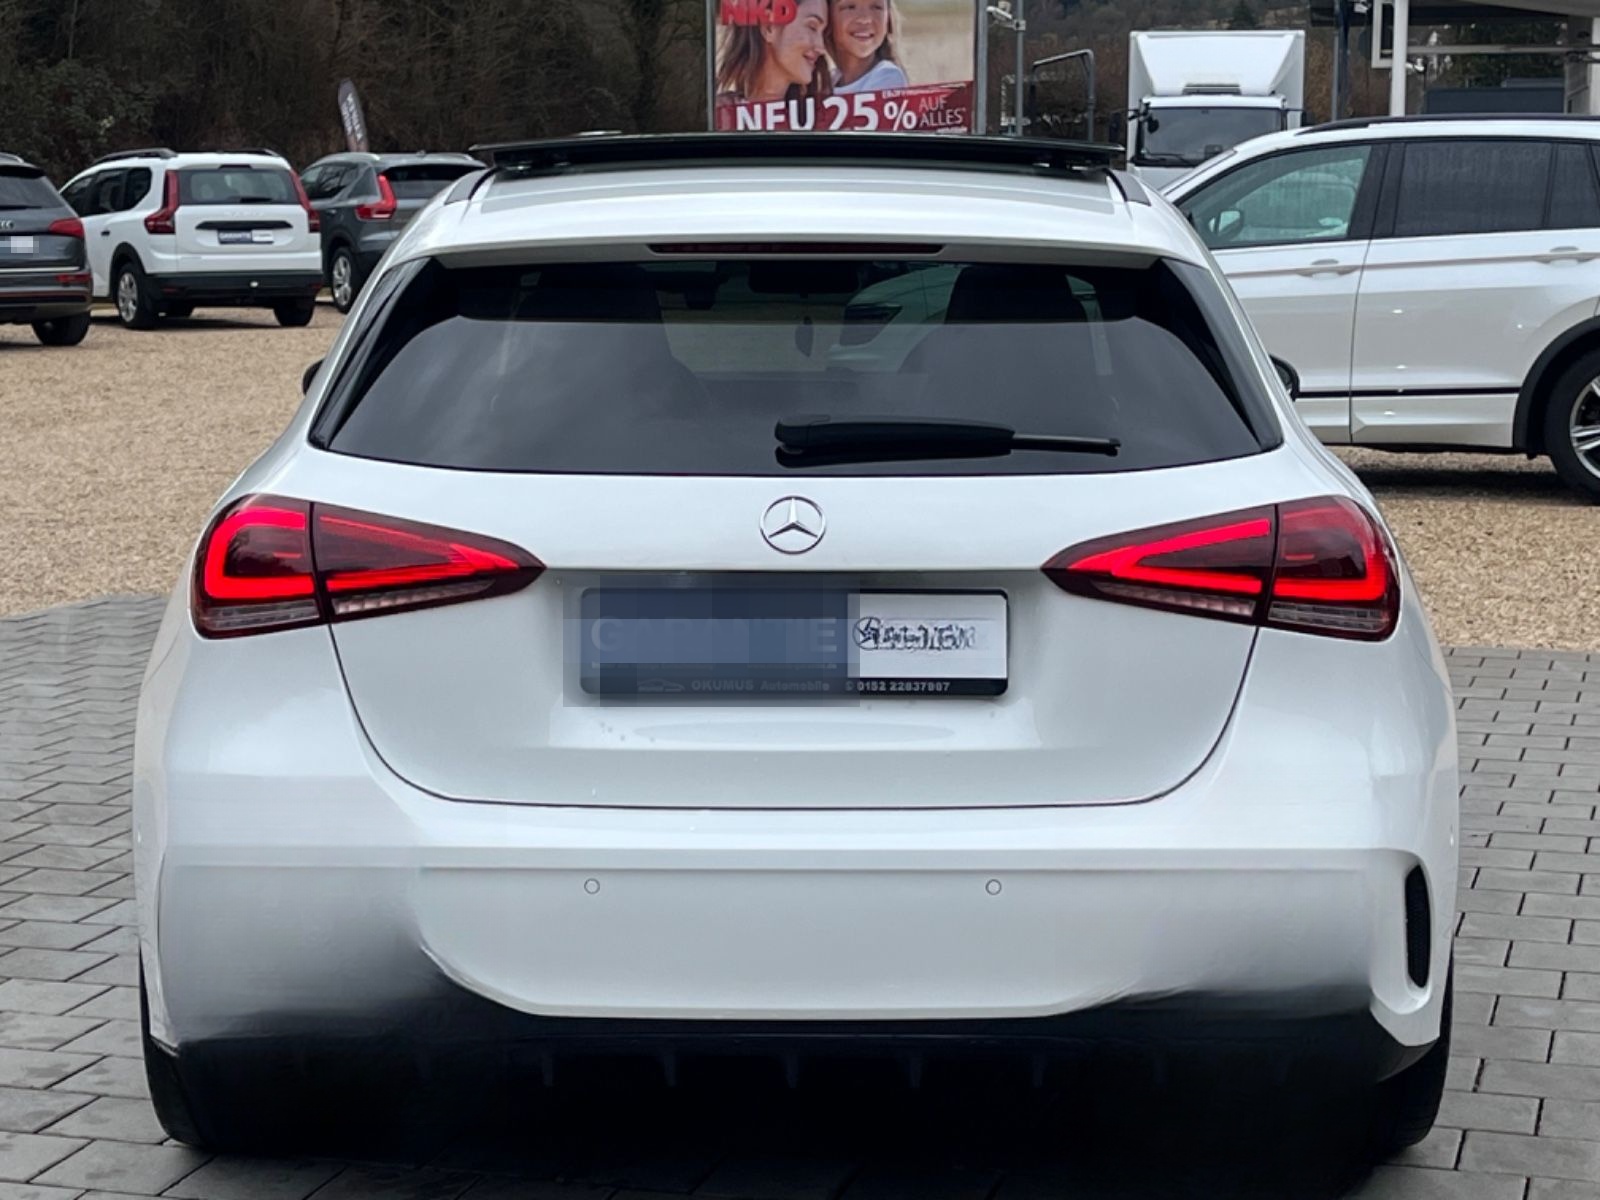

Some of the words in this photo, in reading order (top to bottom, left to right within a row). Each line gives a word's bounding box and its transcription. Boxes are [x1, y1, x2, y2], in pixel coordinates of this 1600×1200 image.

[721, 0, 797, 25] NKD
[919, 94, 948, 112] AUF
[691, 679, 754, 691] OKUMUS
[760, 680, 830, 691] Automobile
[856, 680, 886, 692] 0152
